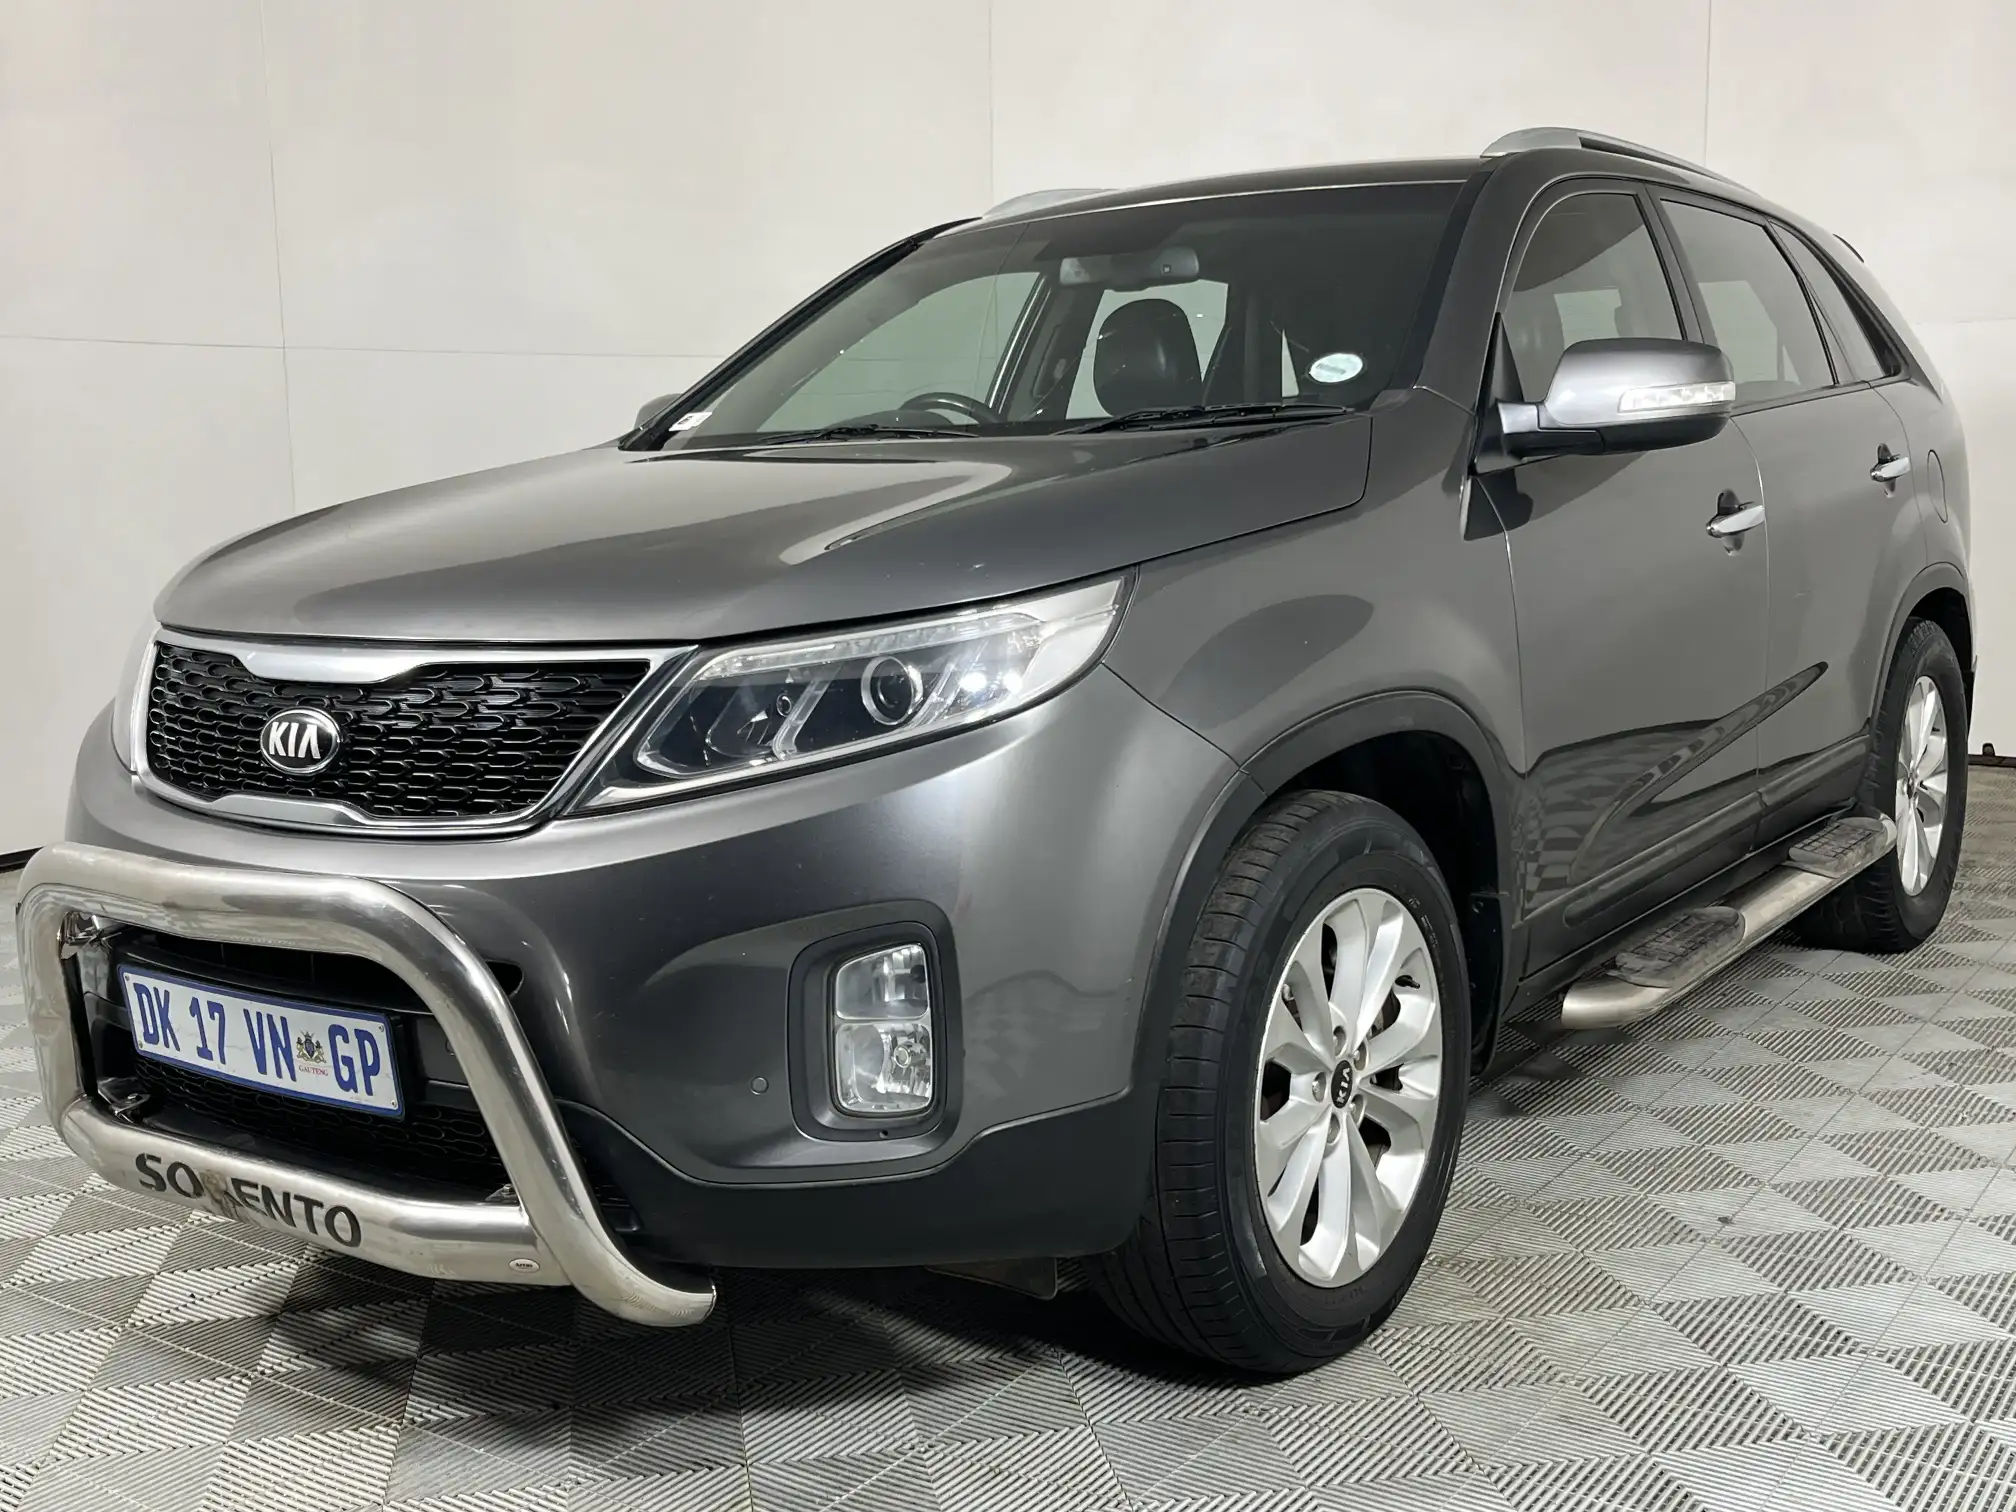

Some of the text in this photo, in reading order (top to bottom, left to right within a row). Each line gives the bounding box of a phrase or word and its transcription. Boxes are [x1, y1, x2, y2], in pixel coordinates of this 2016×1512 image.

[269, 721, 321, 759] KIA
[134, 982, 380, 1096] DK 17 VN GP
[298, 1064, 328, 1076] GAUTENG
[1336, 1067, 1350, 1103] KIA
[136, 1153, 361, 1247] SOENTO
